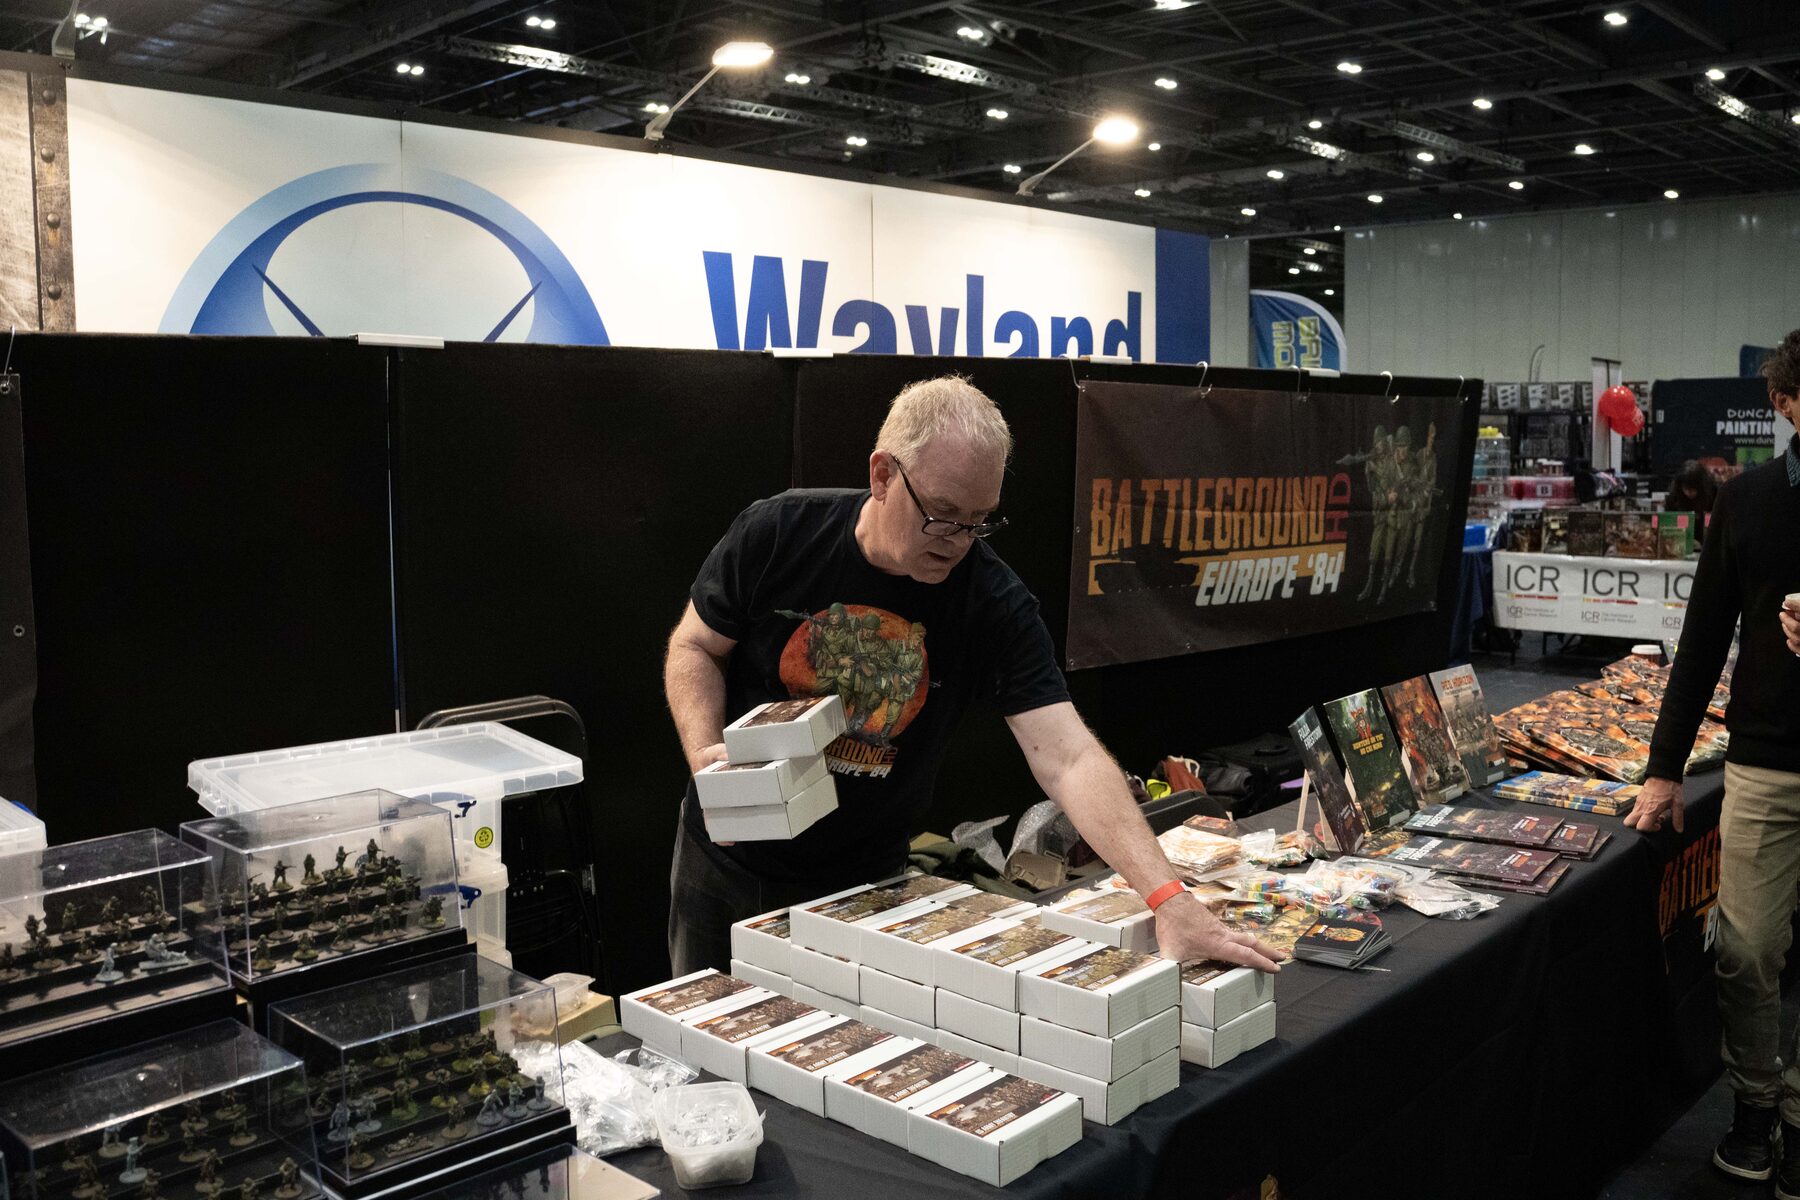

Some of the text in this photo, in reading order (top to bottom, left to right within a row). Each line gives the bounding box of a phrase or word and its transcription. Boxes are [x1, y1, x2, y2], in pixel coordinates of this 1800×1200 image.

[1727, 408, 1773, 419] DUNCA
[1716, 421, 1774, 435] PAINTIN
[1090, 471, 1352, 557] BATTLEGROUND HD
[1195, 551, 1345, 607] EUROPE '84
[1506, 564, 1560, 593] ICR
[1583, 568, 1640, 597] ICR
[1664, 572, 1694, 600] IC
[1581, 611, 1600, 621] ICR
[1662, 615, 1682, 626] ICR
